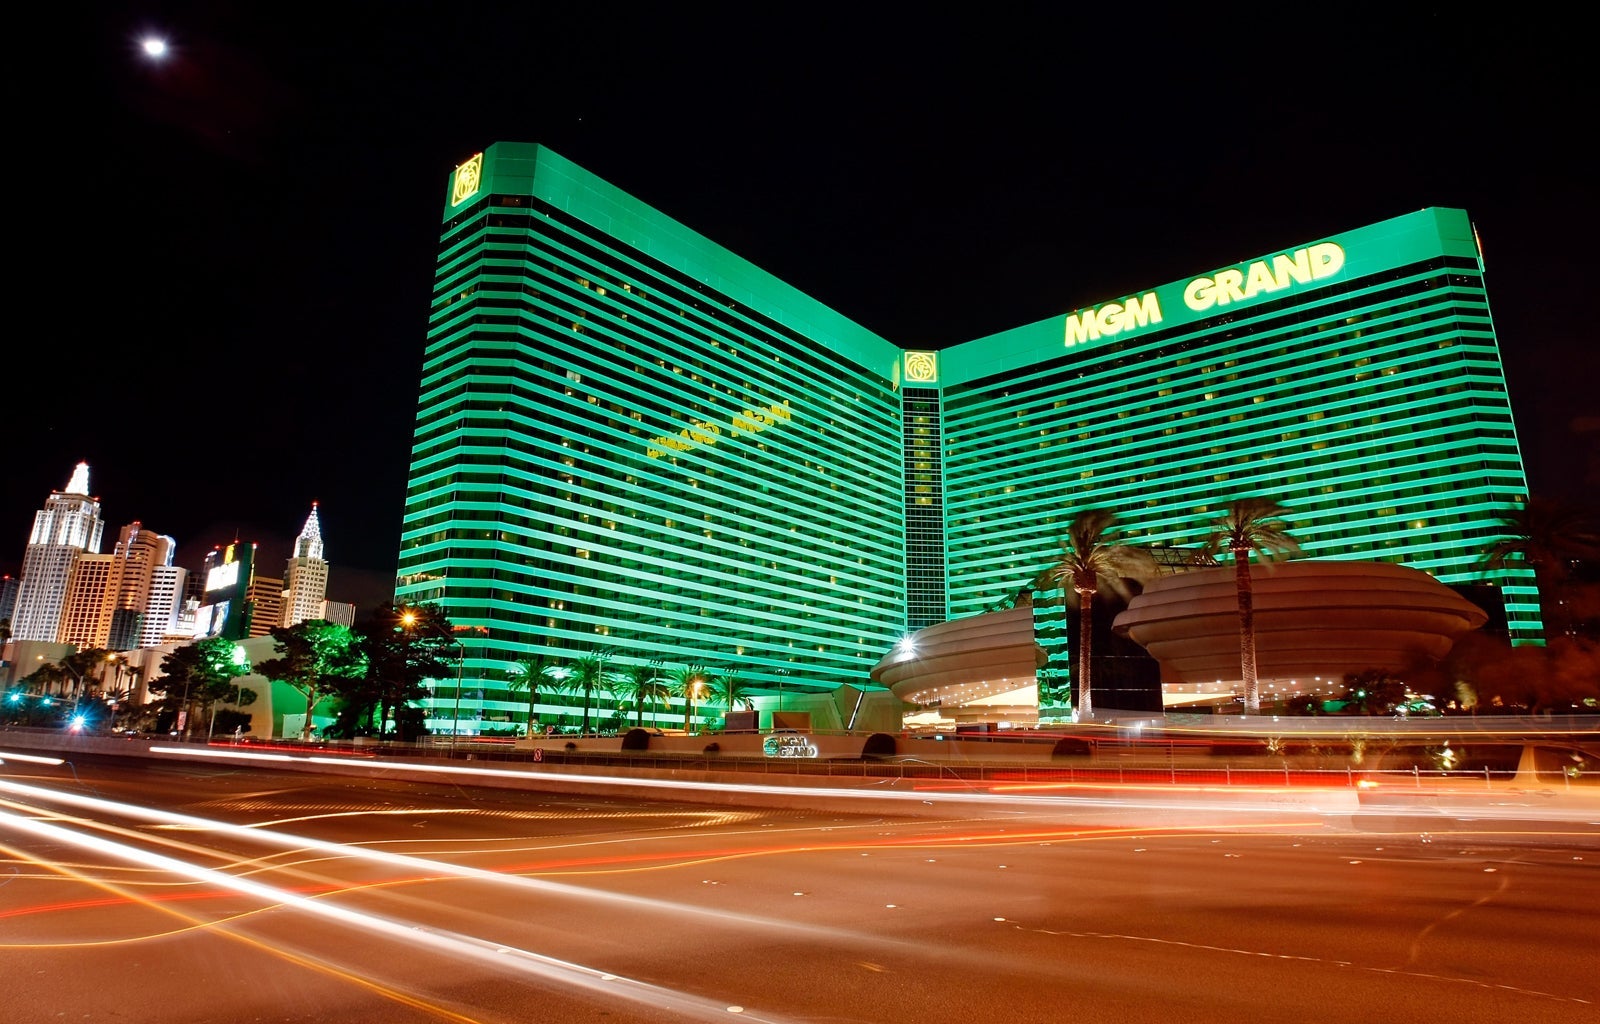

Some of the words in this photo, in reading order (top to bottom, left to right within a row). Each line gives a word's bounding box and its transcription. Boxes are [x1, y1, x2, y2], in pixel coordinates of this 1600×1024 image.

[1064, 292, 1163, 348] MGM
[1183, 242, 1346, 312] GRAND
[780, 746, 816, 757] GRAND
